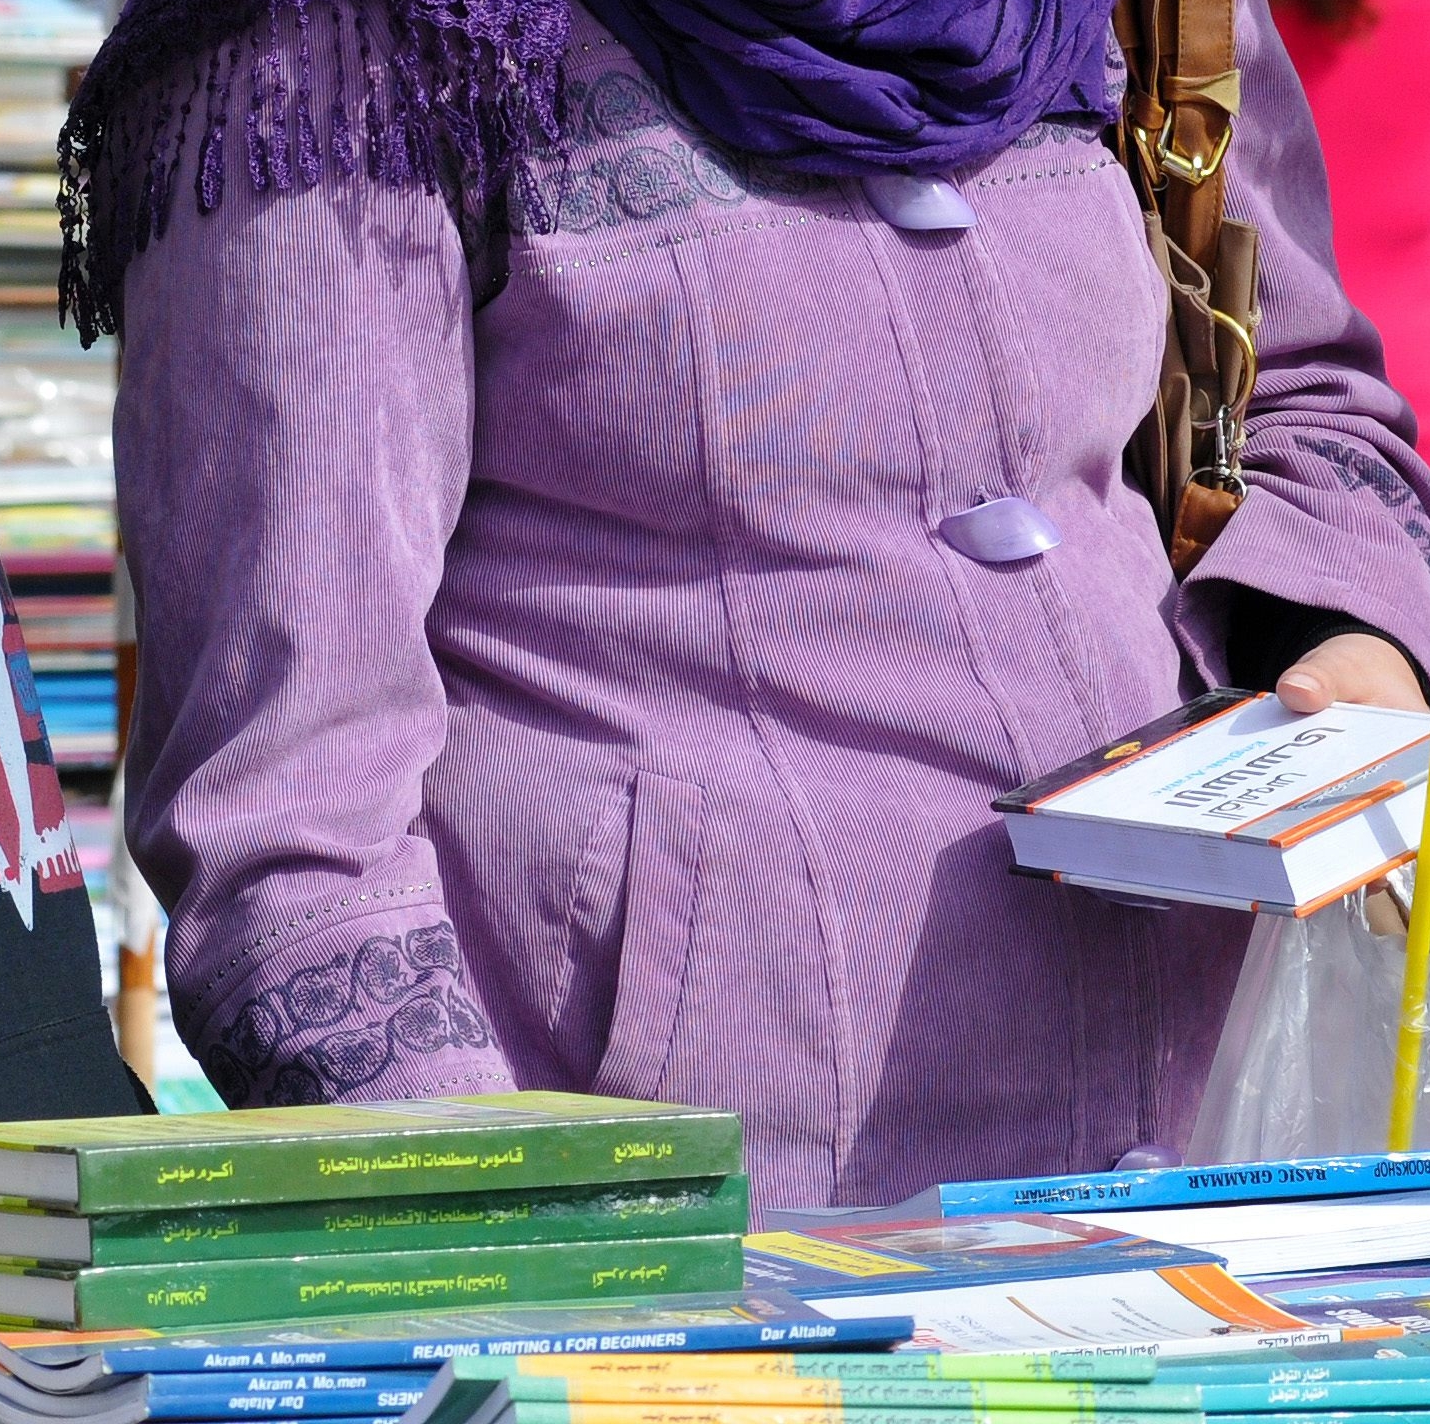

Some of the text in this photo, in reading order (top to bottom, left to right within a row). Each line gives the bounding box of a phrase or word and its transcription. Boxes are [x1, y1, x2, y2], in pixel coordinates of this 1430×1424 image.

[421, 1151, 479, 1168] مصطلحات
[479, 1147, 524, 1168] قاموس
[656, 1142, 673, 1159] دار
[370, 1152, 421, 1171] الاقتصاد
[157, 1159, 234, 1184] أكرم مؤمن
[1187, 1167, 1327, 1190] BASIC GRAMMAR
[300, 1280, 344, 1302] قاموس
[345, 1280, 402, 1295] مصطلحات
[760, 1323, 837, 1342] Dar Altalae
[412, 1332, 687, 1360] READING WRITING & FOR BEGINNERS
[204, 1353, 250, 1368] Akram
[248, 1377, 293, 1392] Akram
[228, 1395, 304, 1411] Dar Altalae
